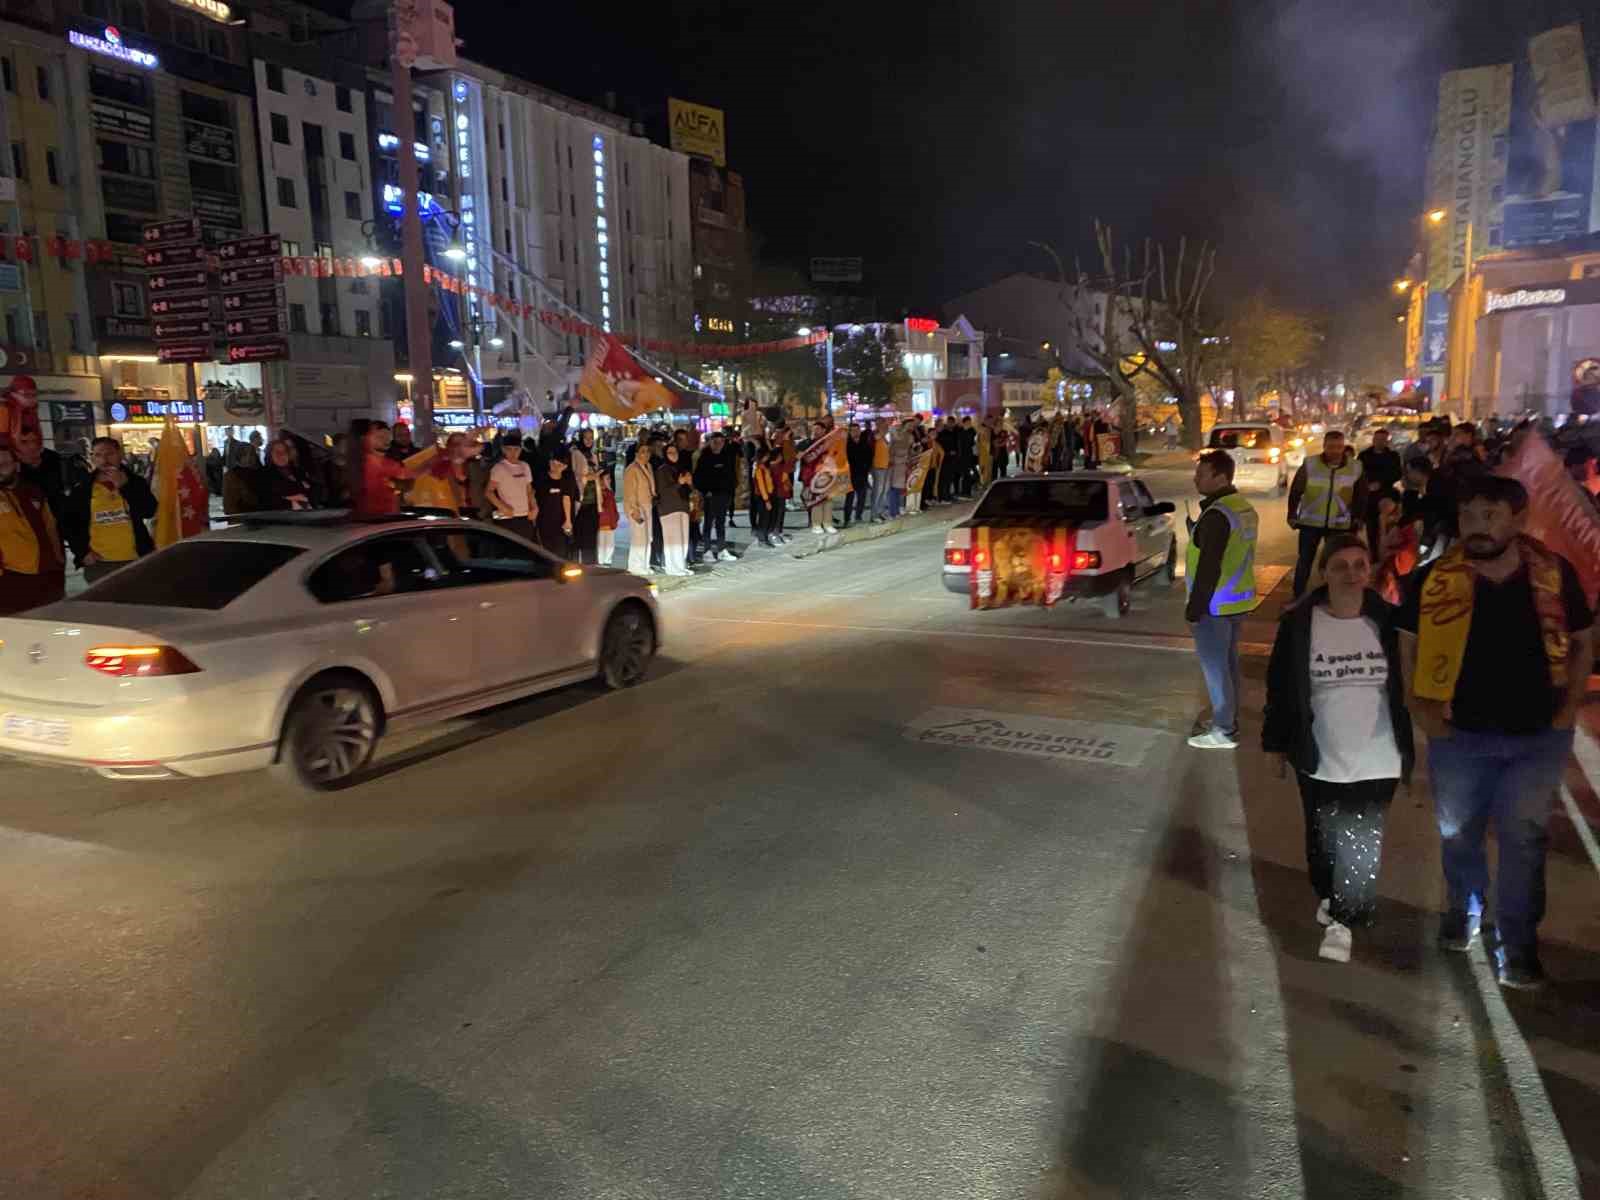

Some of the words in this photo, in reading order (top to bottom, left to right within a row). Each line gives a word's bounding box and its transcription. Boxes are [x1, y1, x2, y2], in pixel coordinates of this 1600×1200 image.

[1315, 653, 1324, 662] A
[1327, 651, 1362, 664] good
[1336, 665, 1365, 678] give
[1369, 666, 1385, 676] yo
